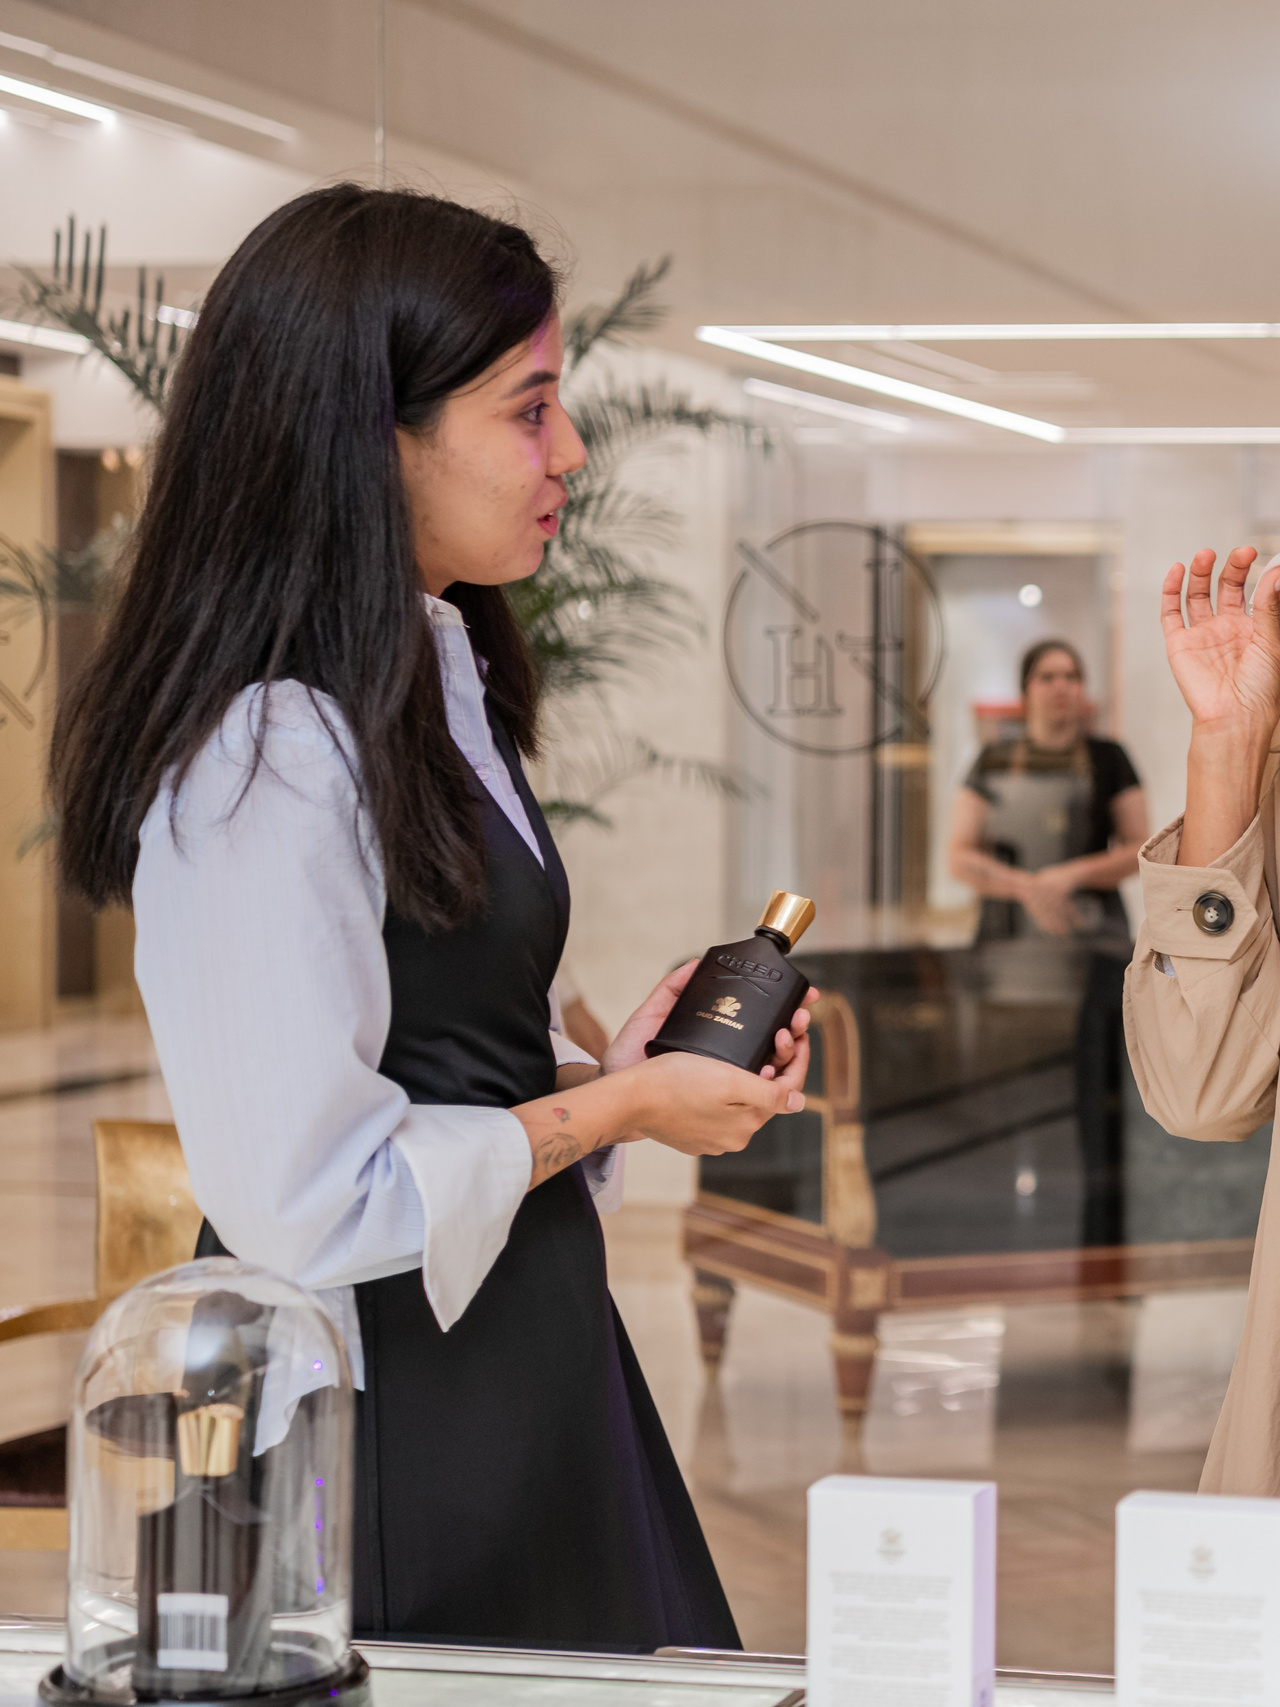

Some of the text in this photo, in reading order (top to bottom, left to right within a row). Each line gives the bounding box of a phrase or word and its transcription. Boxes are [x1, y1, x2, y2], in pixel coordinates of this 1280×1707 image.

[716, 955, 783, 983] CREED
[695, 1011, 745, 1030] OUD ZARIAN
